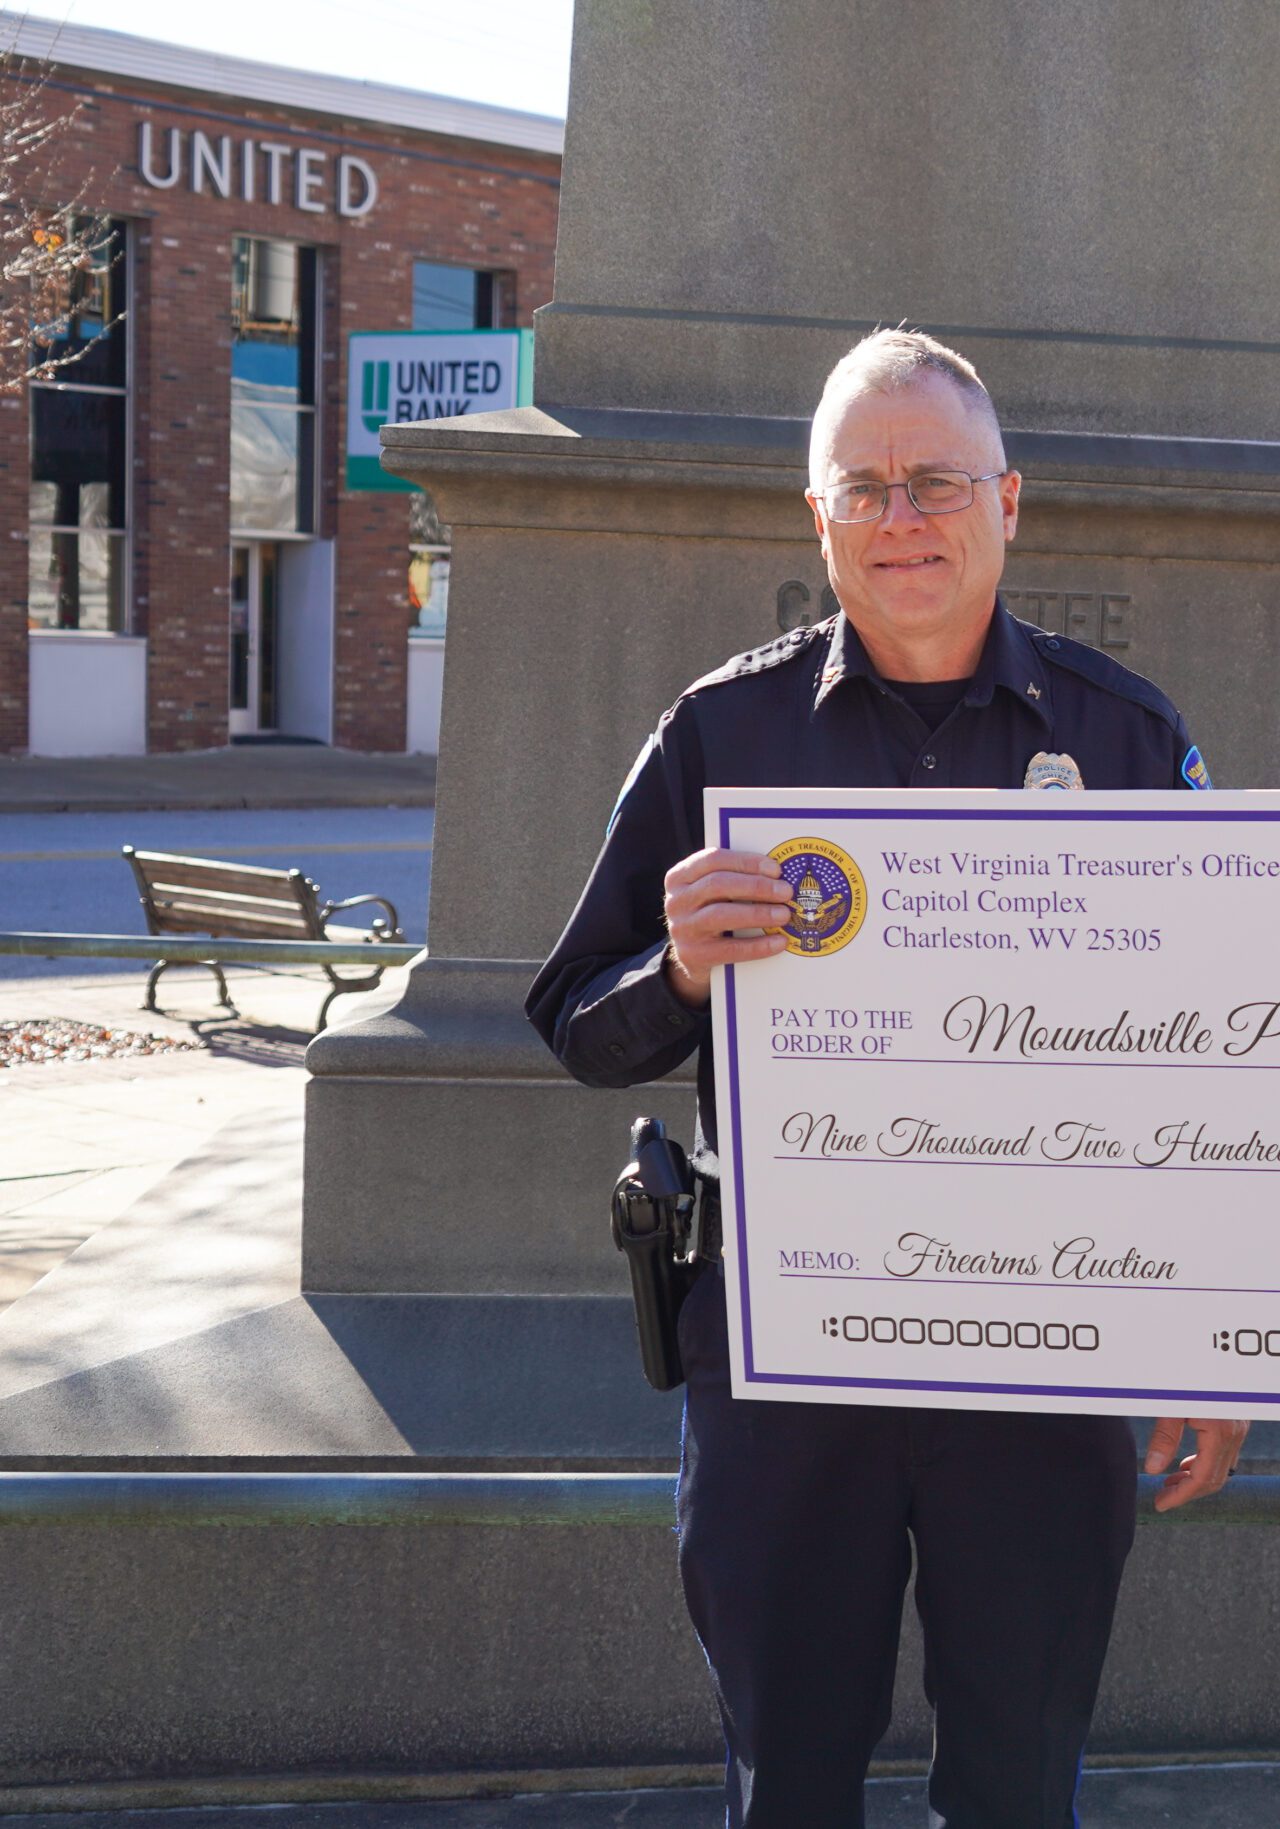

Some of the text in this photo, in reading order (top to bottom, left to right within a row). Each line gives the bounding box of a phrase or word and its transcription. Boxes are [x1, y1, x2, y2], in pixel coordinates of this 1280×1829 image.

[138, 121, 379, 218] UNITED
[396, 360, 502, 395] UNITED
[1037, 765, 1073, 776] POLICE
[1041, 773, 1069, 781] CHIEF
[798, 843, 844, 864] TREASURER
[880, 851, 1280, 881] West Virginia Treasurer's Office
[849, 873, 858, 884] OF
[881, 888, 1088, 919] Capitol Complex
[830, 915, 859, 944] VIRGINIA
[882, 925, 1161, 952] Charleston, WV 25305
[771, 1008, 913, 1030] PAY TO THE
[942, 995, 1213, 1060] Moundsville
[771, 1033, 893, 1055] ORDER OF
[781, 1111, 868, 1157] Nine
[876, 1116, 1036, 1158] Thousand
[1040, 1120, 1125, 1163] Two
[779, 1232, 1178, 1281] MEMO: Firearms Auction
